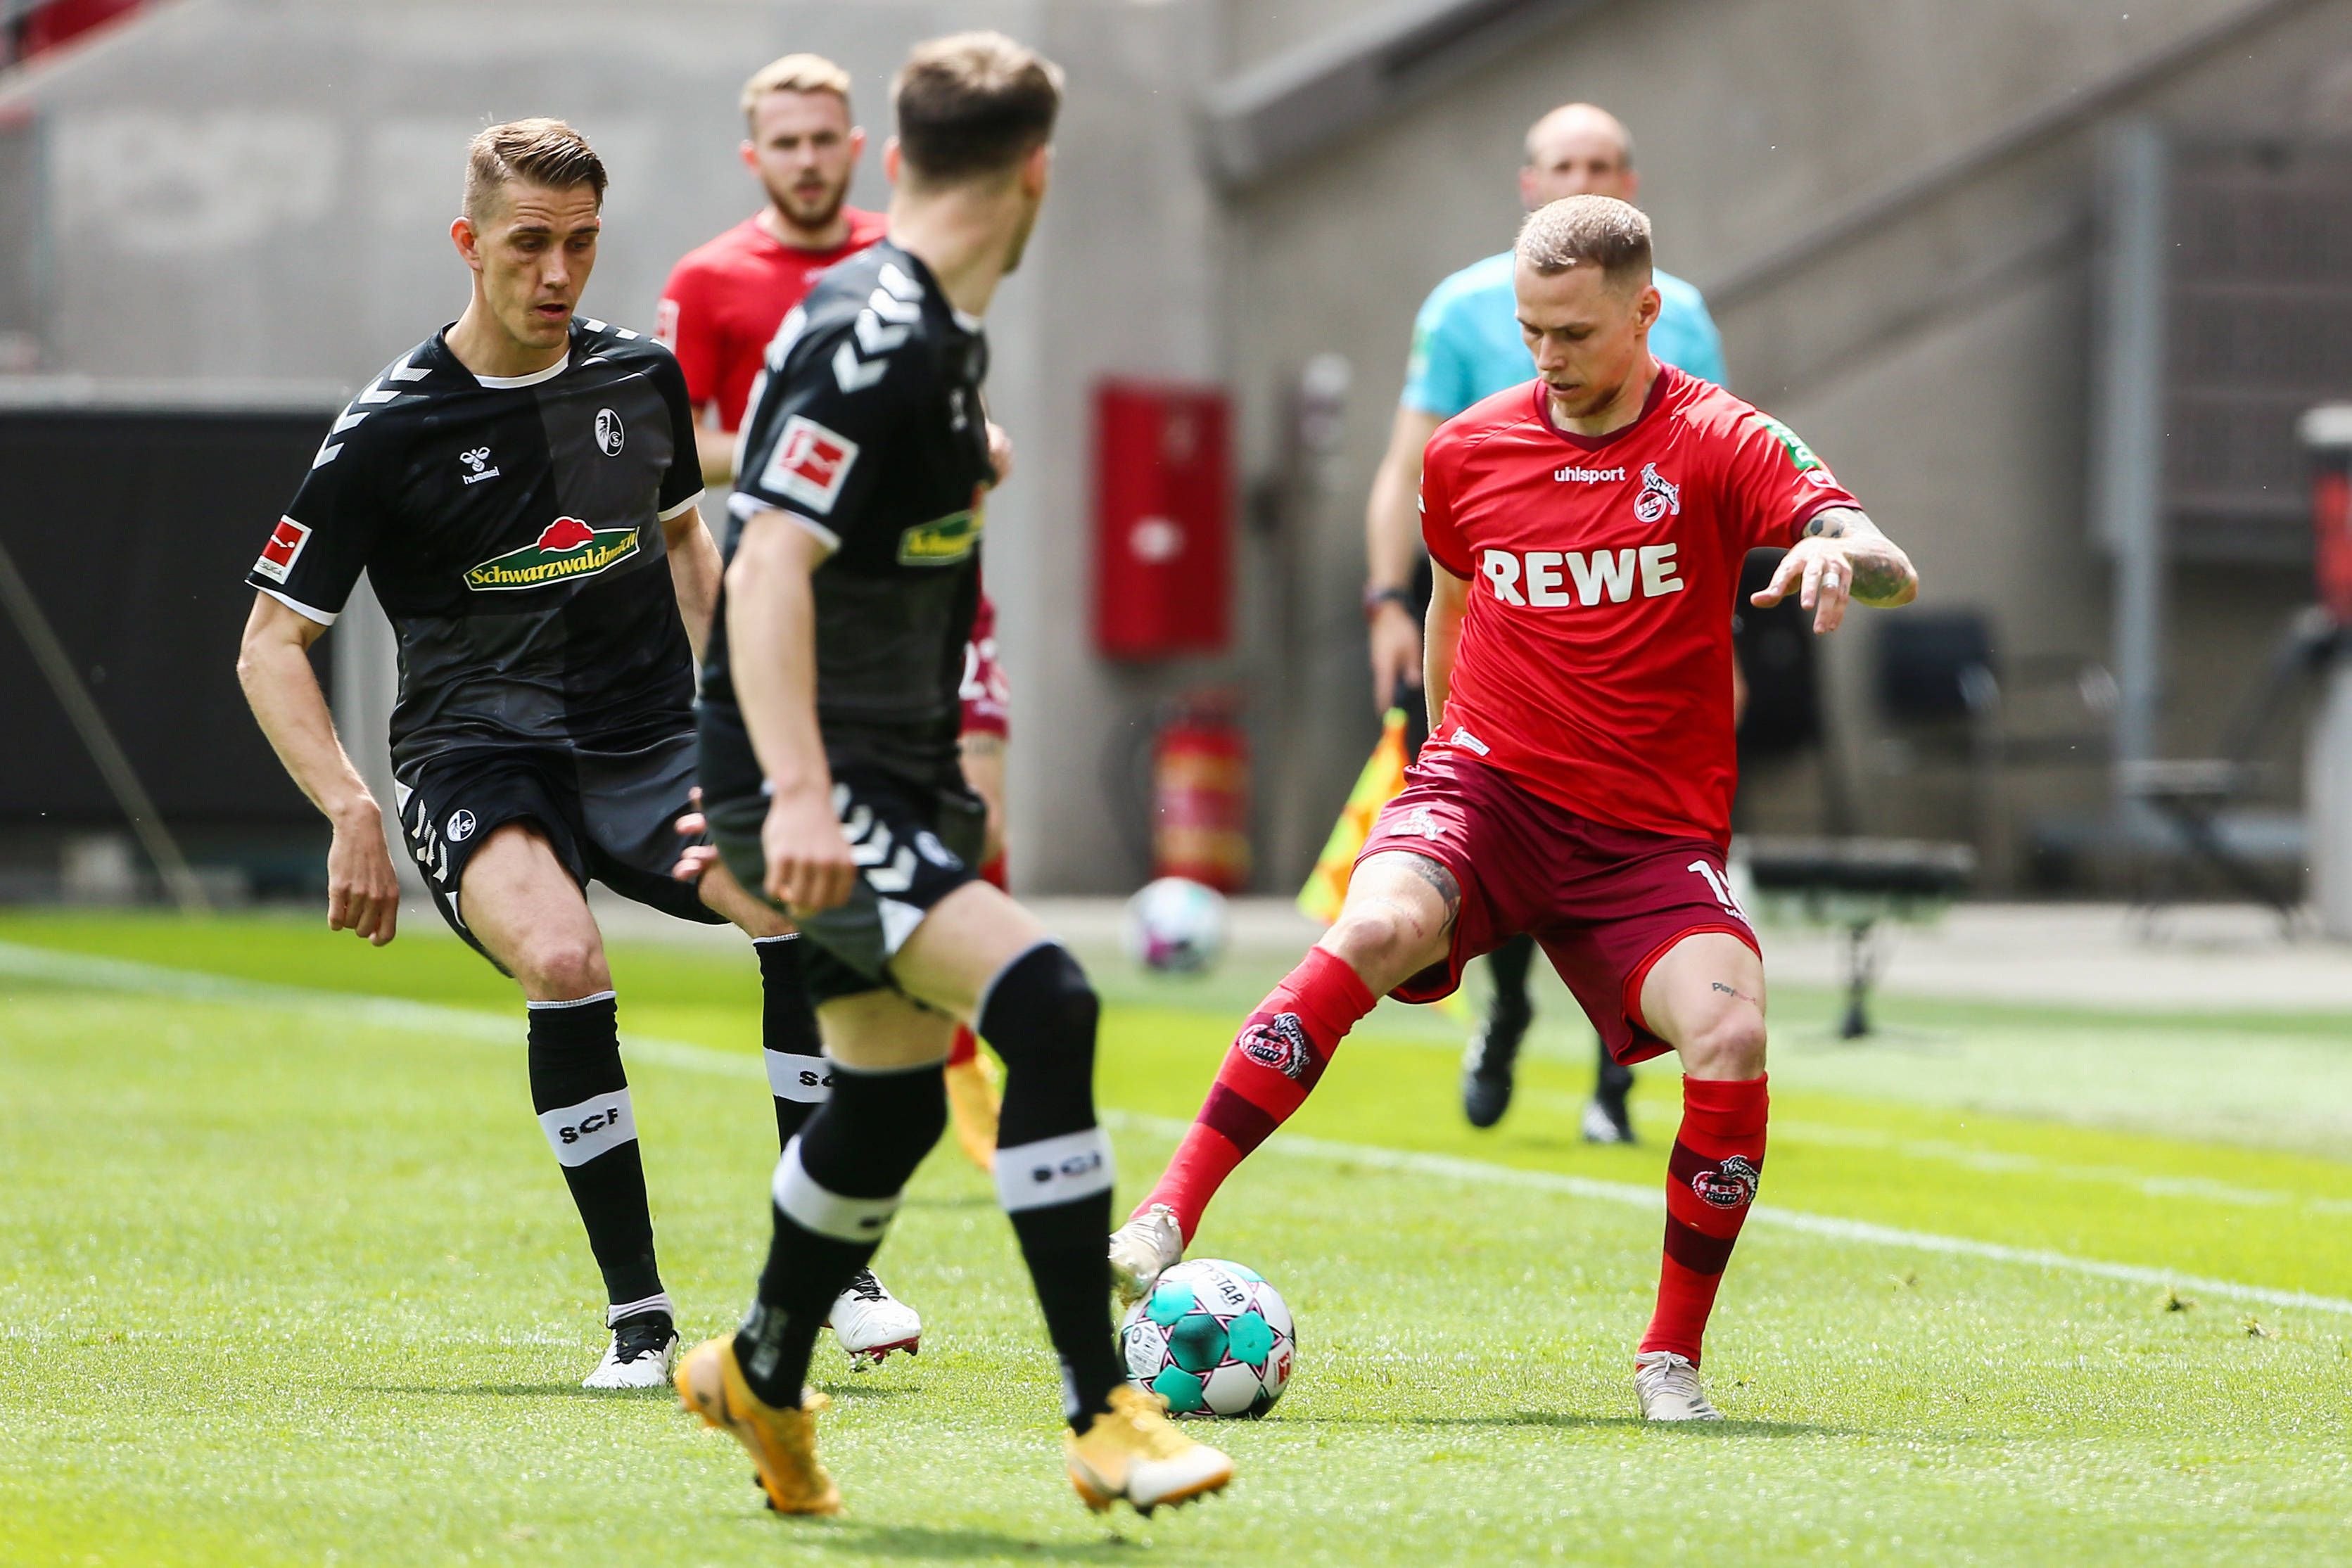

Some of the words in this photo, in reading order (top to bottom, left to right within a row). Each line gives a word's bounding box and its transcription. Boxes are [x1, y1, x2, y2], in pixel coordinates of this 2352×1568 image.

[462, 466, 500, 485] hummel
[1554, 466, 1625, 485] uhlsport
[1482, 542, 1684, 607] REWE
[559, 1108, 618, 1144] SCF
